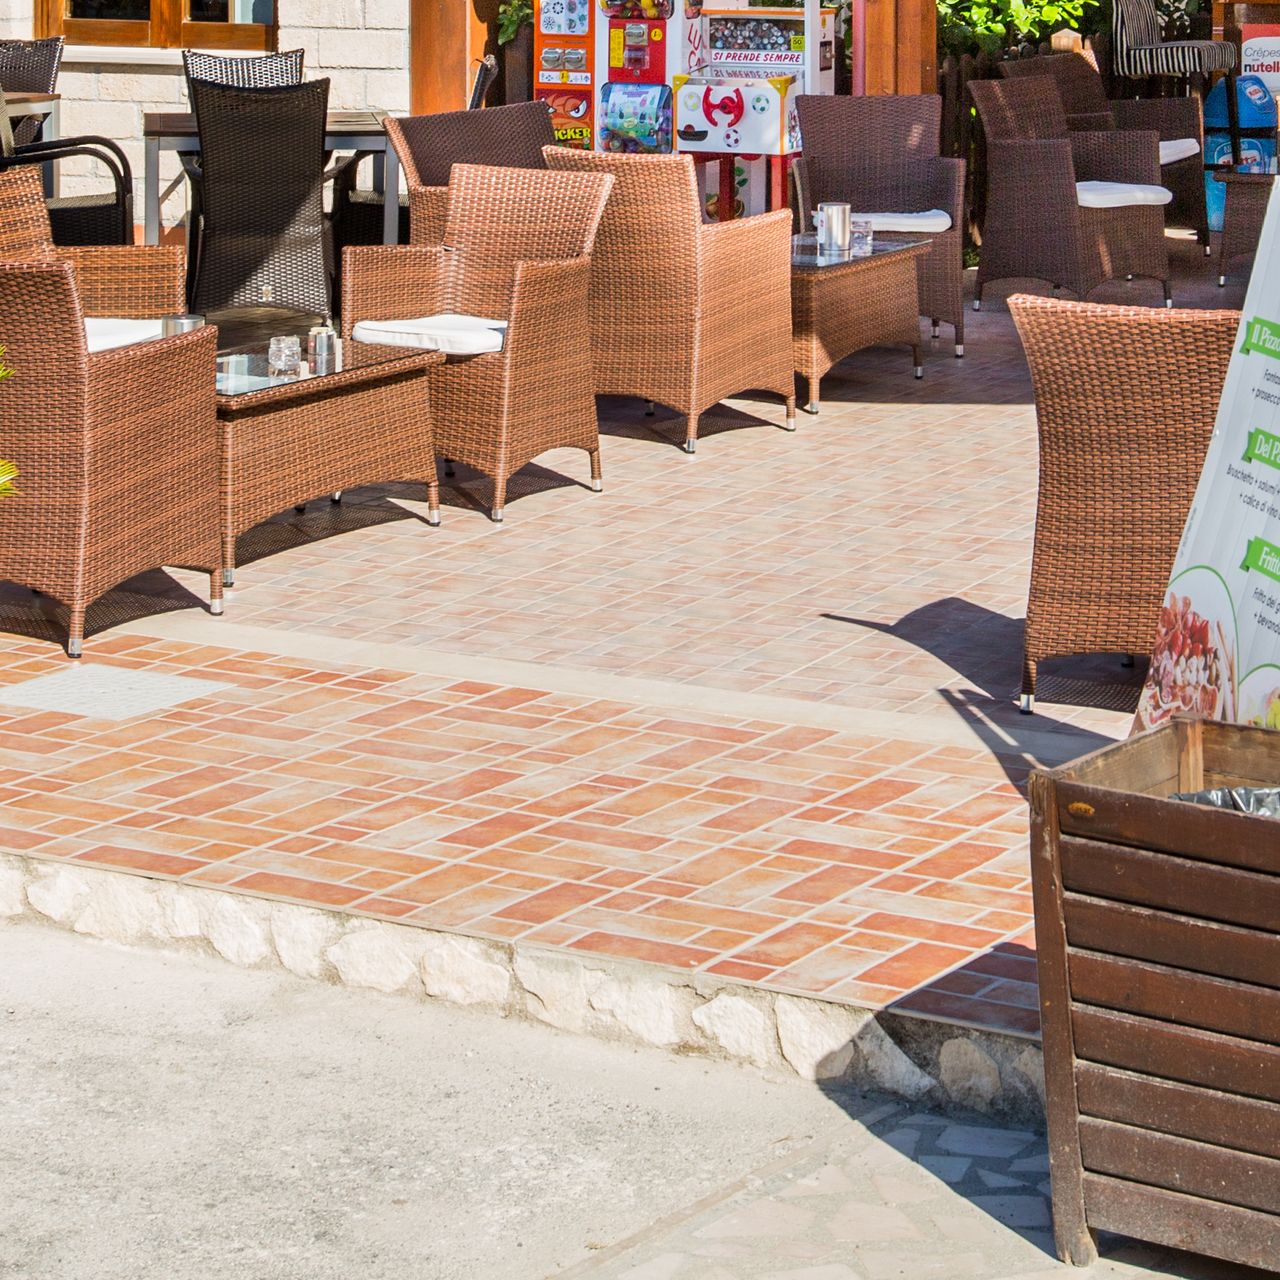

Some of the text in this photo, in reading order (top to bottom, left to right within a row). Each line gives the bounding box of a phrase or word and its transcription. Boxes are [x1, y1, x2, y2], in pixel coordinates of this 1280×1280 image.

[713, 52, 801, 63] SI PRENDE SEMPRE
[554, 127, 591, 141] ICKER
[1251, 324, 1261, 344] Il
[1255, 388, 1280, 407] prosecco
[1254, 434, 1273, 458] Del
[1257, 480, 1276, 495] salumi
[1242, 494, 1260, 510] calice
[1266, 504, 1278, 518] vino
